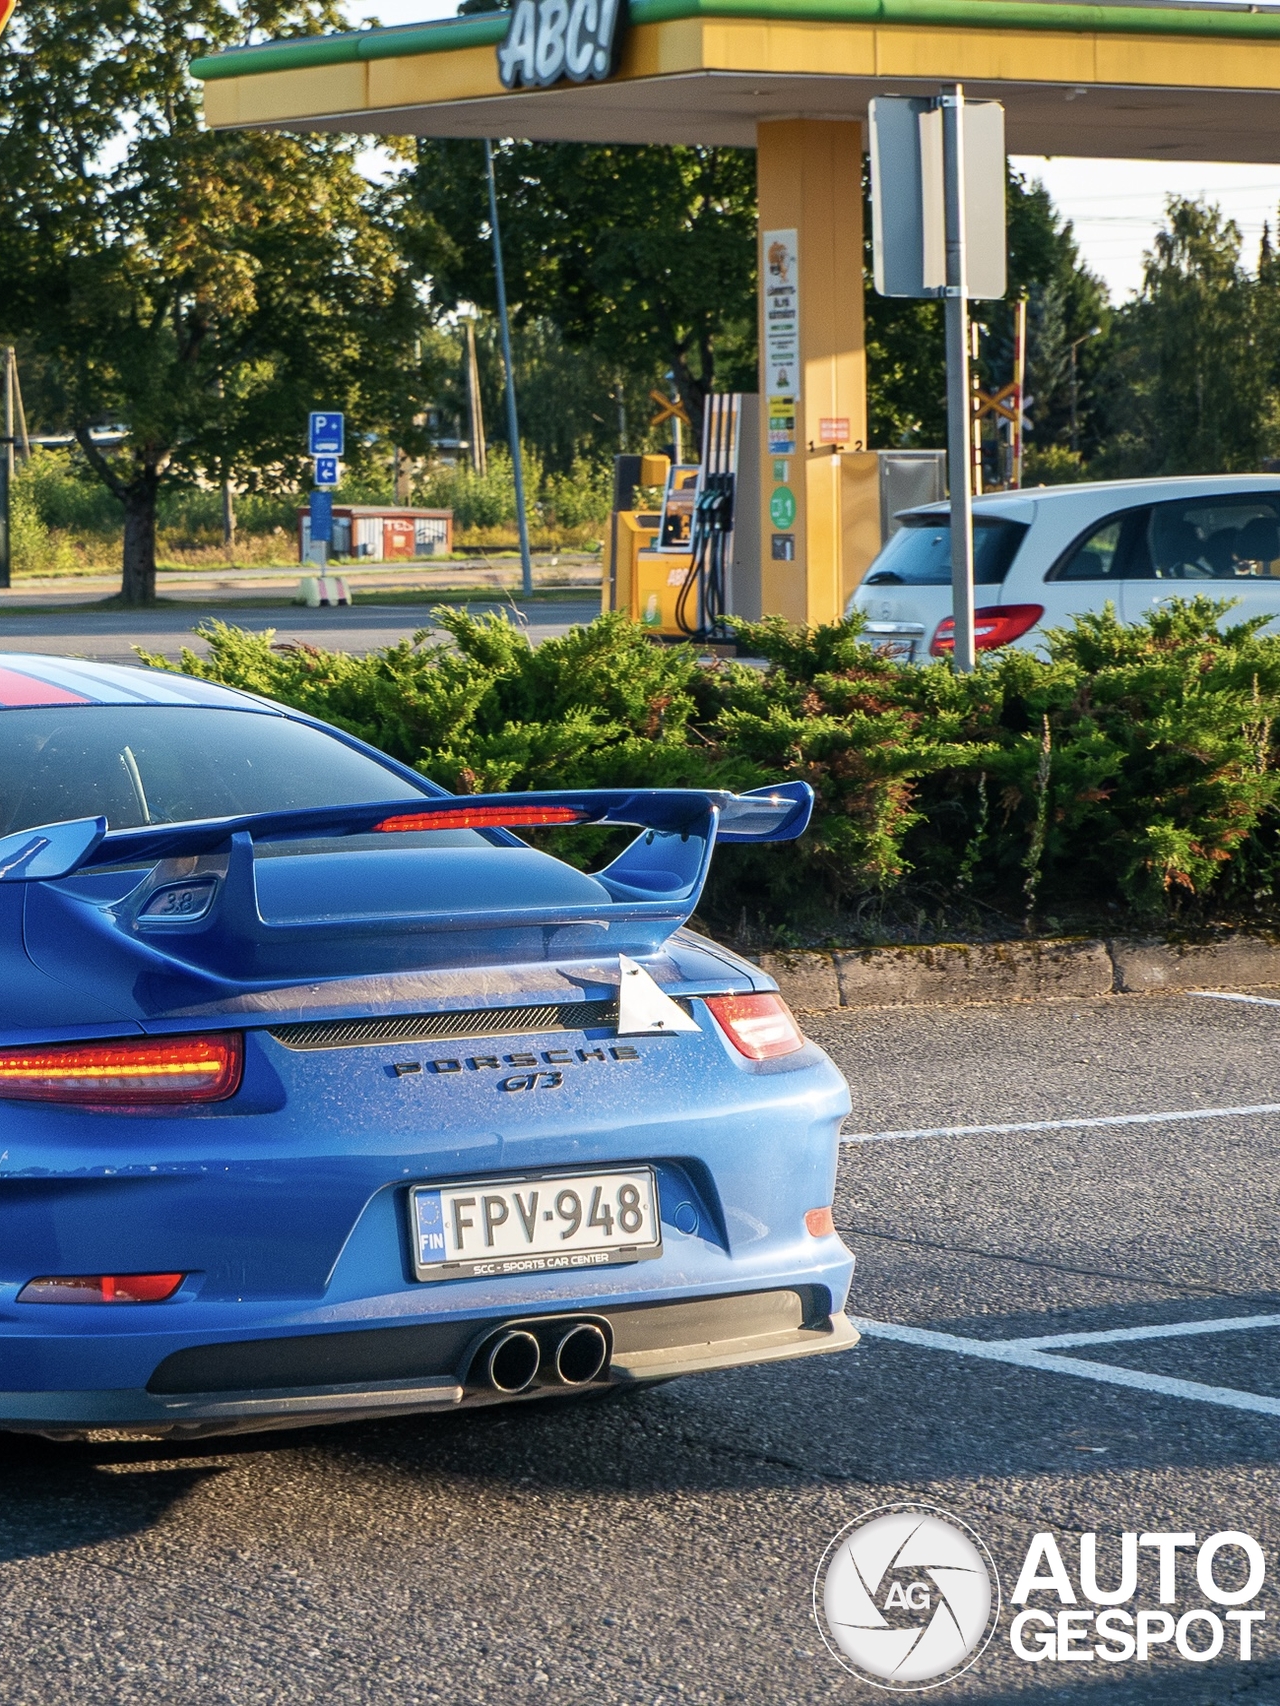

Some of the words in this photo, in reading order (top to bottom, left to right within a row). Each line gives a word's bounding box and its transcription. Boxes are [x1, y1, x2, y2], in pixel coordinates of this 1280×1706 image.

[500, 0, 619, 82] ABC!
[315, 416, 327, 434] P
[164, 892, 193, 914] 3.8
[393, 1045, 640, 1077] PORSCHE
[503, 1071, 564, 1092] GT3
[421, 1233, 444, 1251] FIN
[452, 1183, 644, 1251] FPV-948
[473, 1264, 495, 1275] SCC
[503, 1260, 545, 1272] SPORTS
[546, 1256, 569, 1268] CAR
[571, 1253, 609, 1265] CENTER
